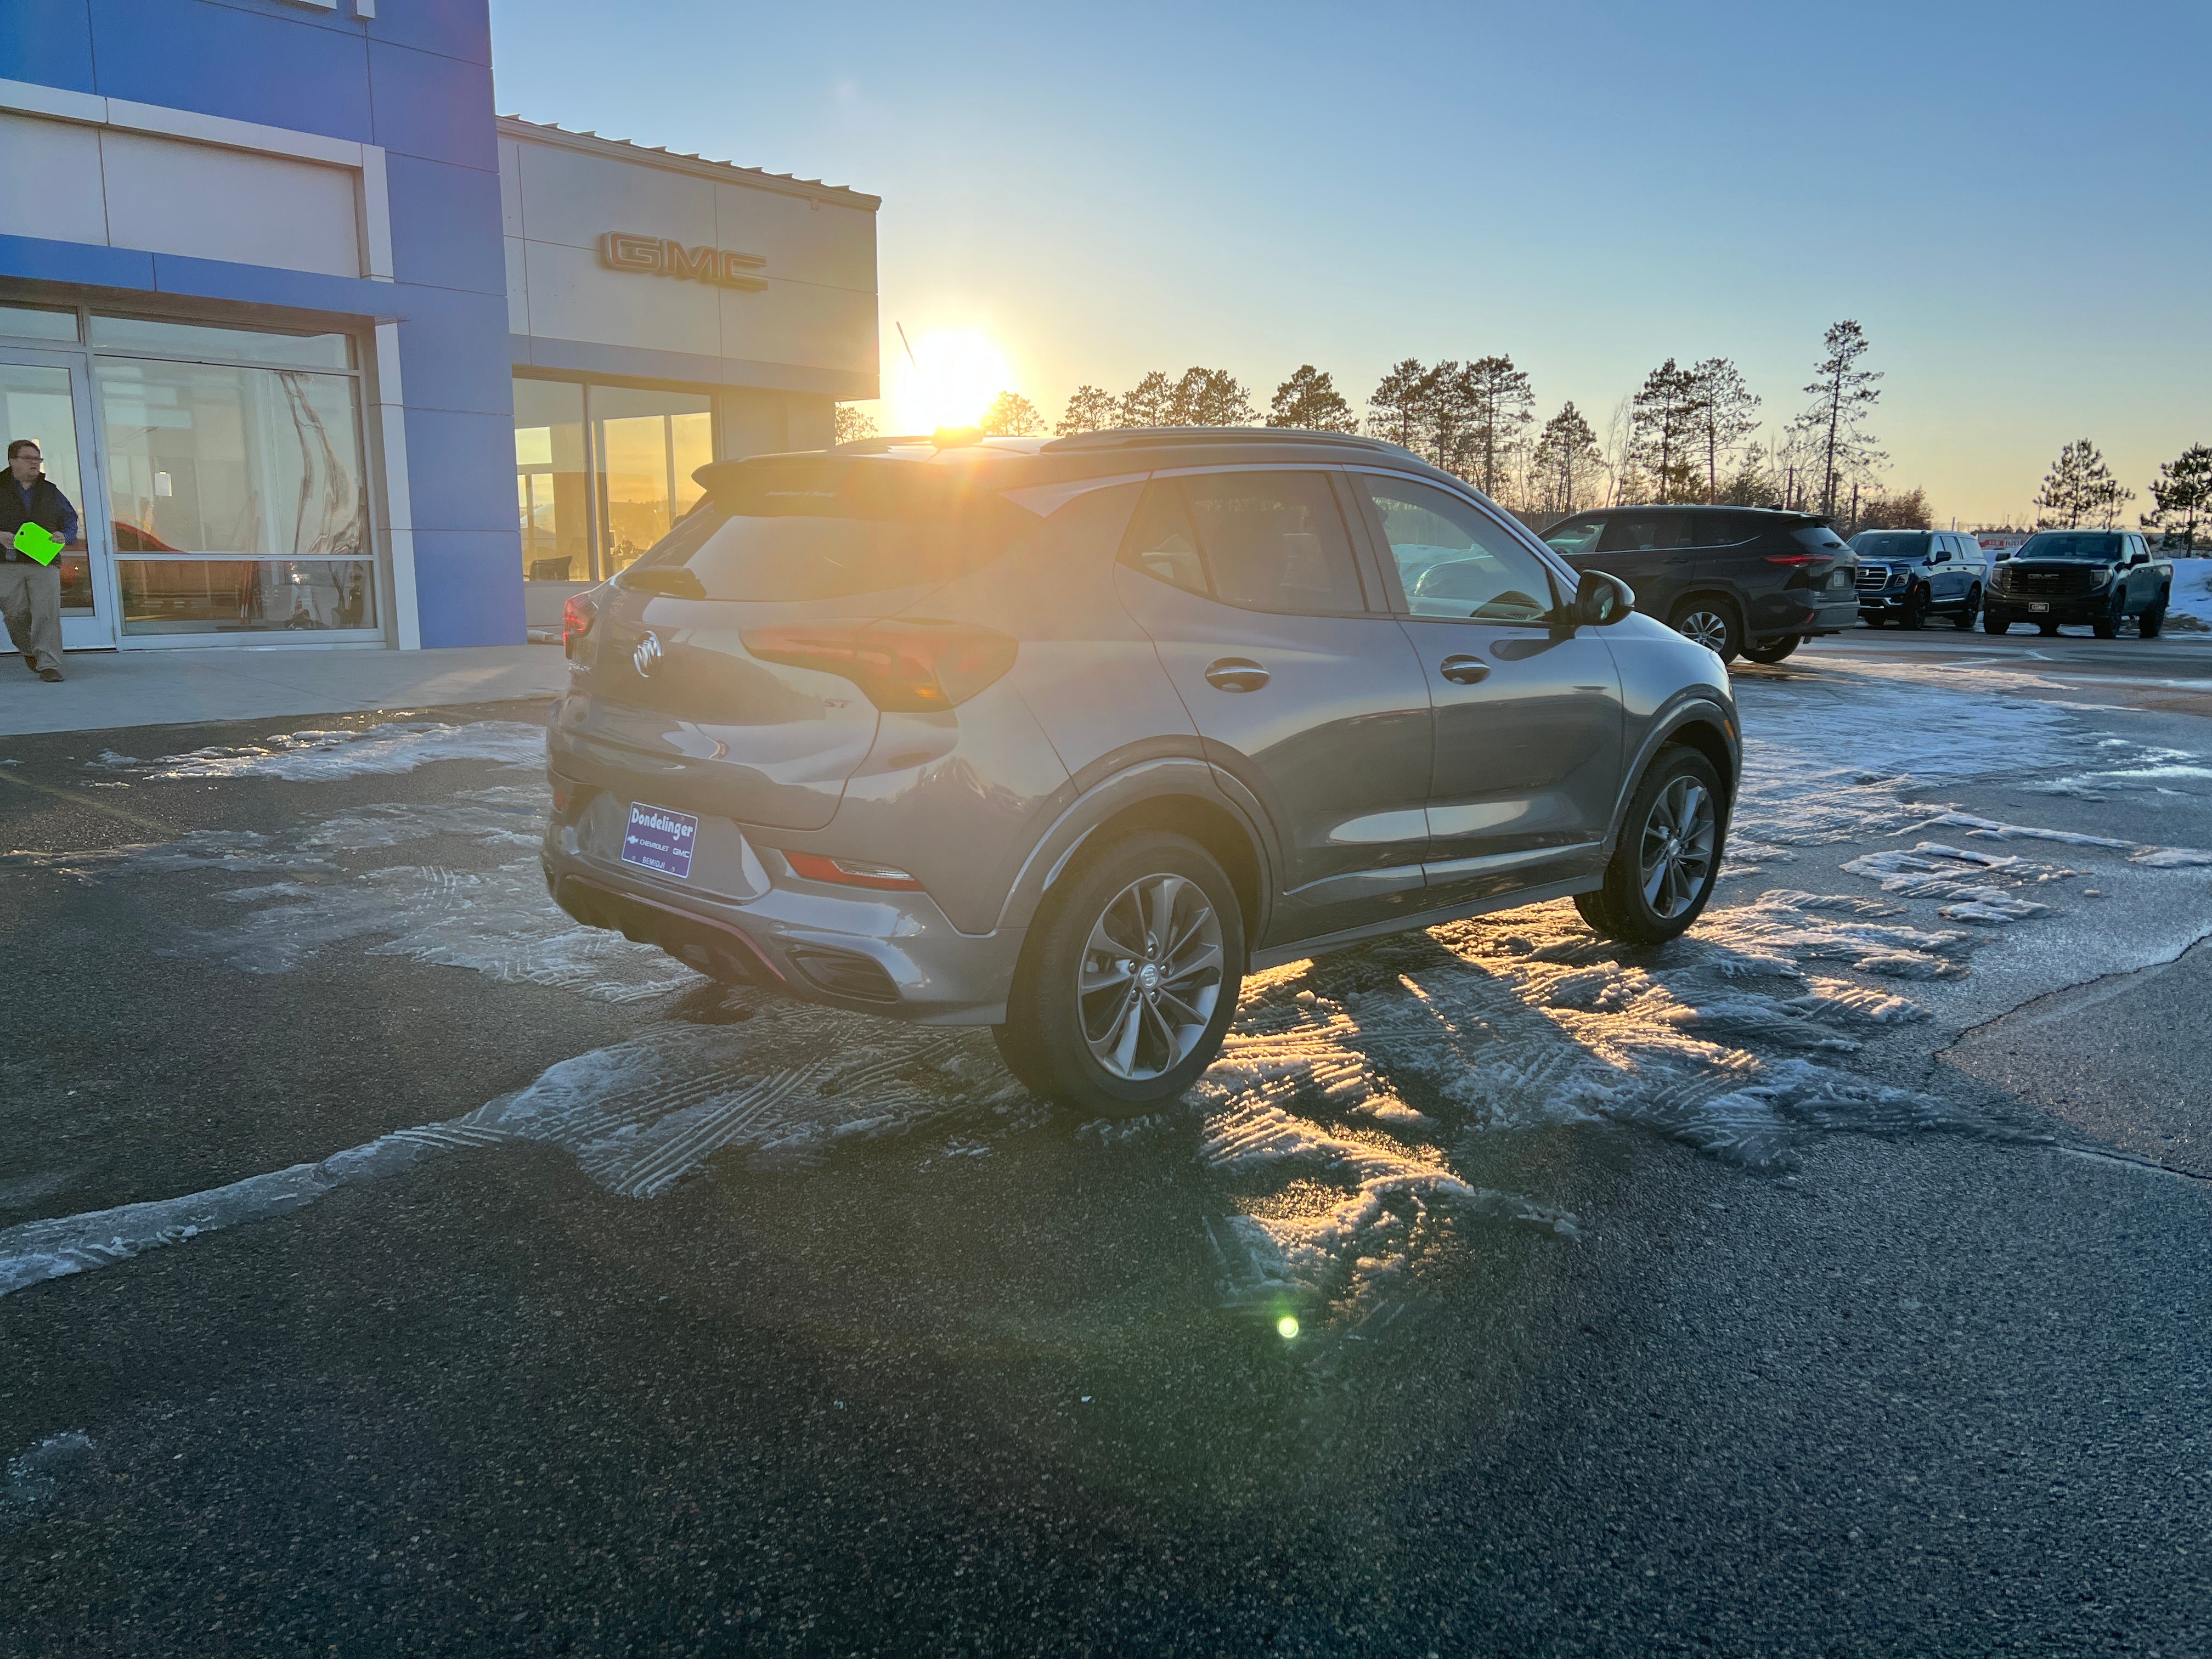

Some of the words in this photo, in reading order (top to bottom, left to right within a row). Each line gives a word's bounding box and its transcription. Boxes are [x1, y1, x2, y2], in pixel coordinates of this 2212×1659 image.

[601, 231, 768, 287] GMC
[631, 808, 693, 841] Dondelinger
[640, 839, 669, 852] CHEVROLET
[673, 848, 690, 858] GMC
[642, 856, 665, 869] BEMIDJI
